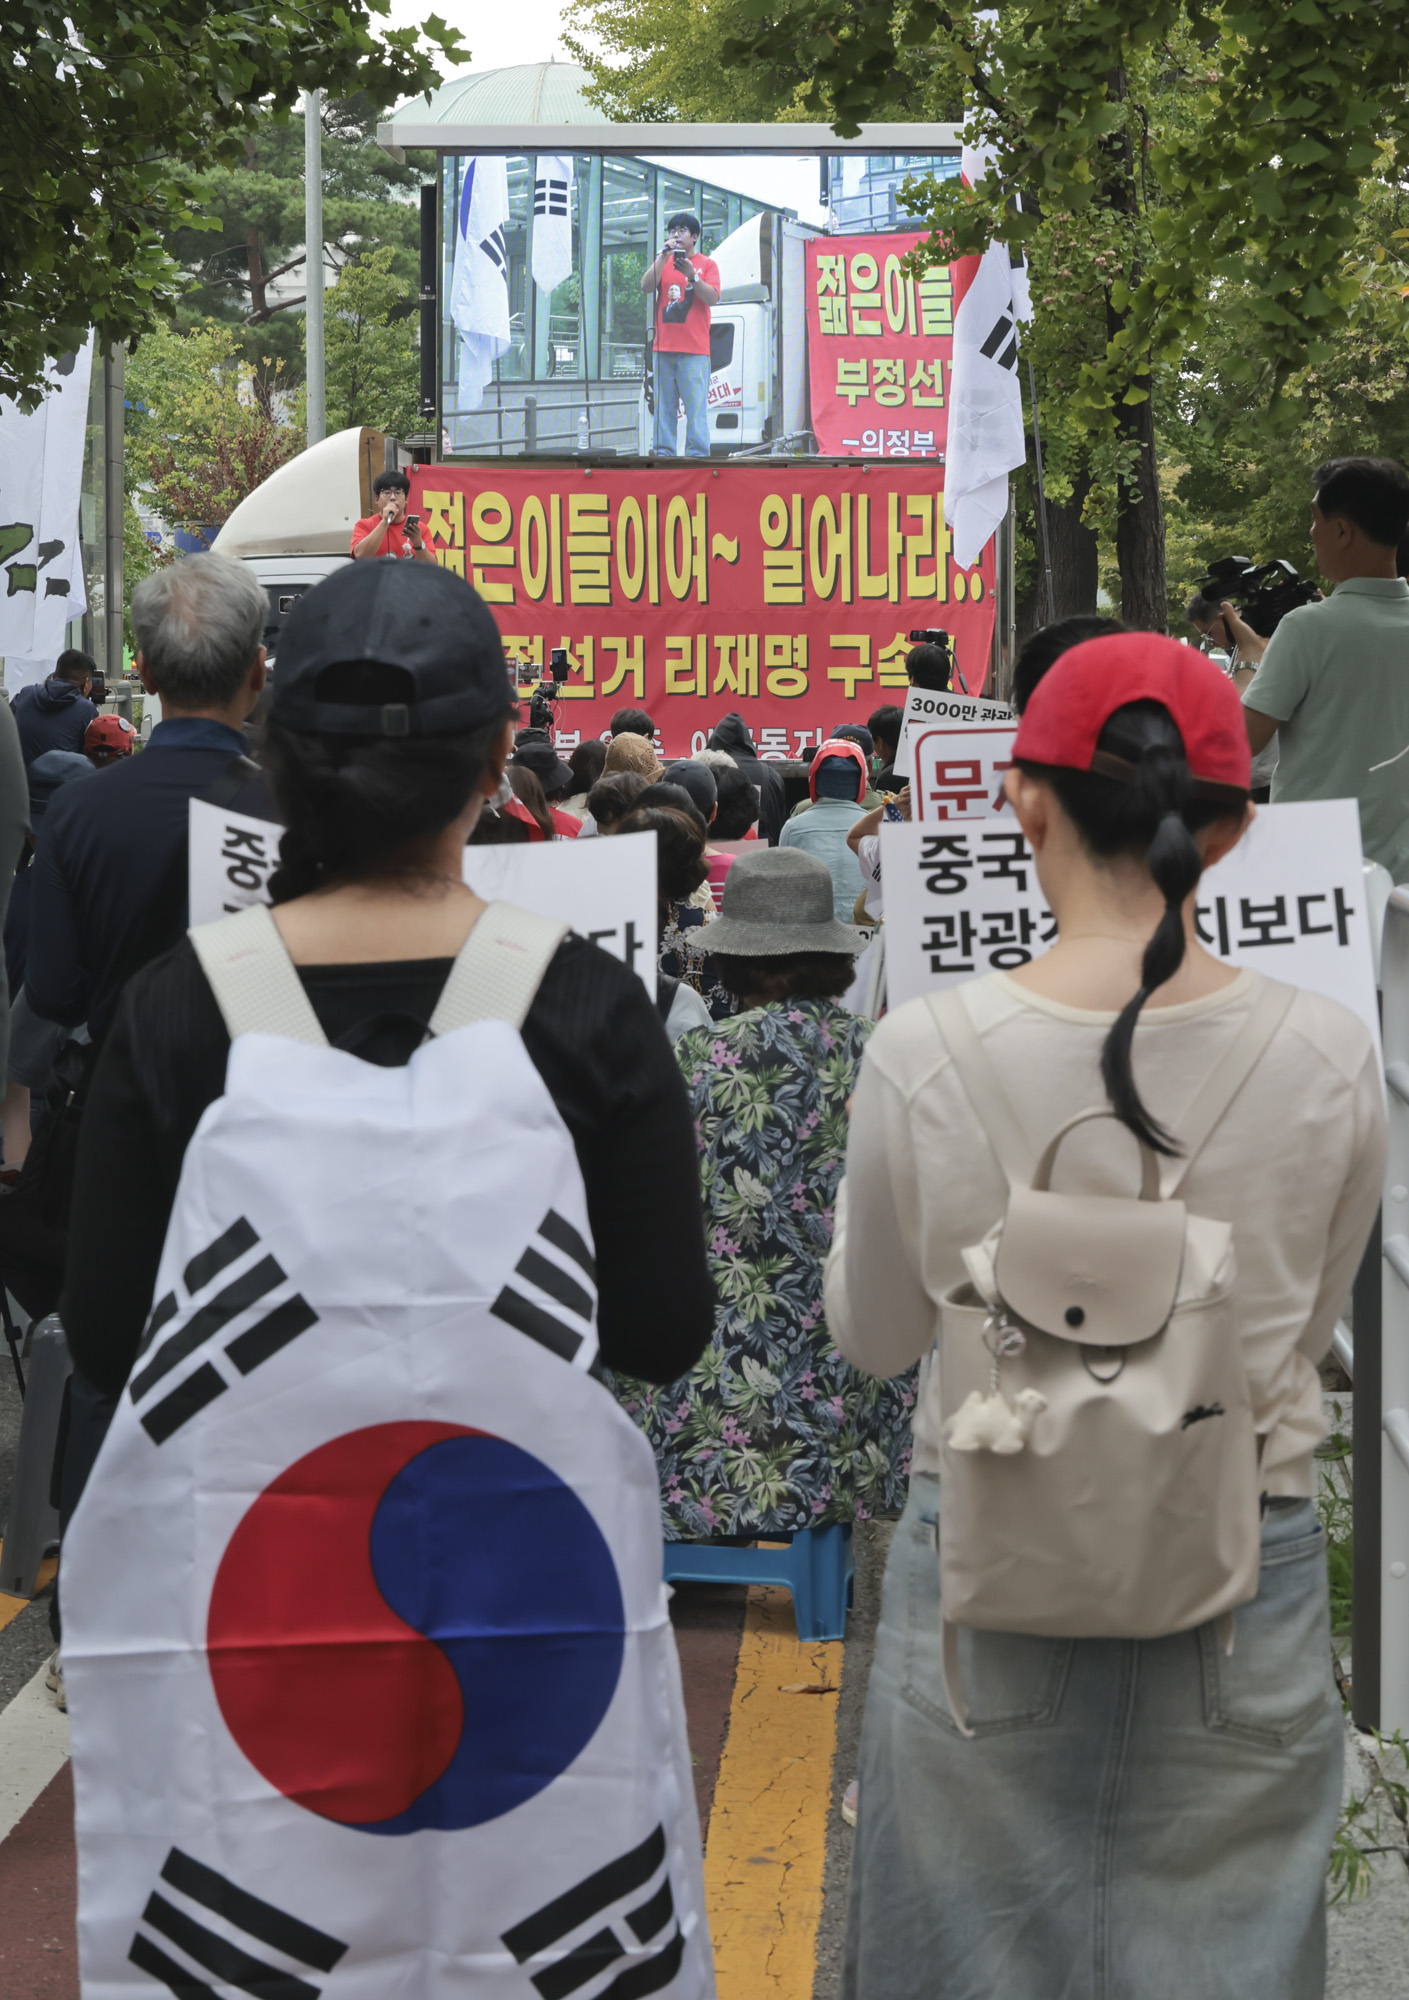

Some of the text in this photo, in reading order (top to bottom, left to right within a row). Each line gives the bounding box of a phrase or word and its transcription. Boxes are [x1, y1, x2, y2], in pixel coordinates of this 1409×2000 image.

[835, 358, 953, 408] 부정선
[759, 491, 983, 605] 일어나라
[665, 633, 808, 698] 리재명
[911, 697, 978, 722] 3000만
[918, 833, 1033, 895] 중국
